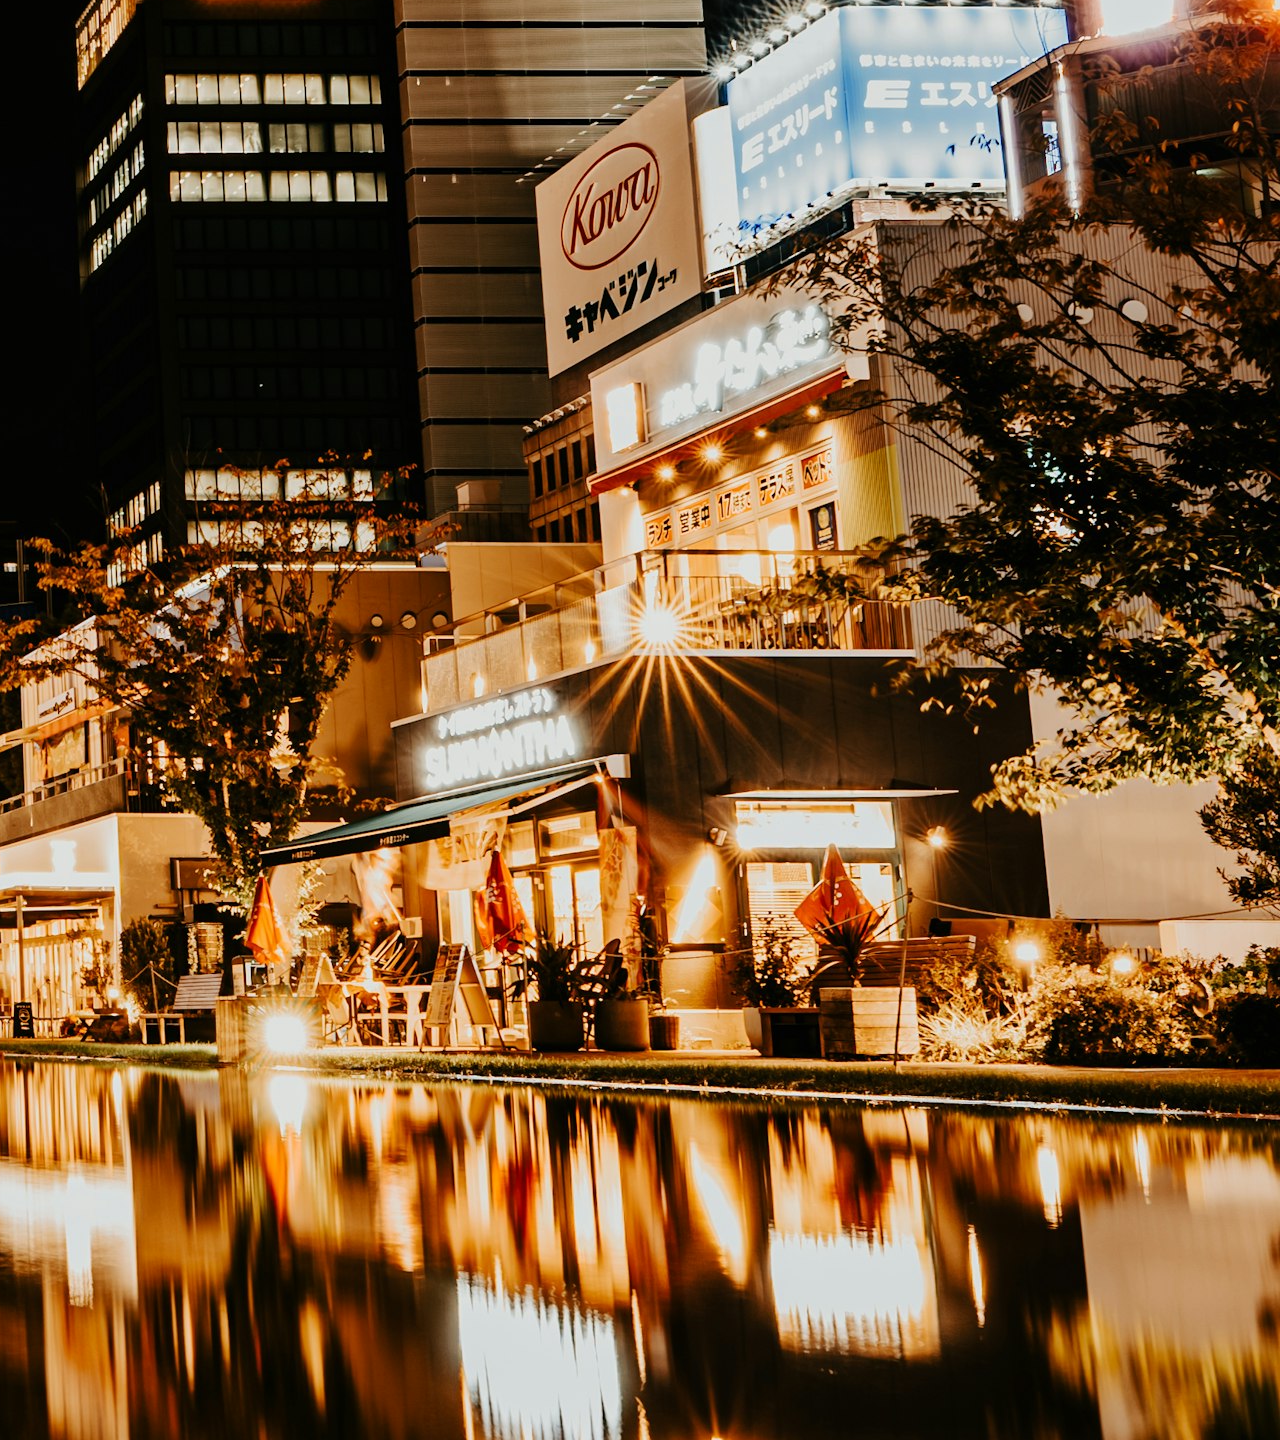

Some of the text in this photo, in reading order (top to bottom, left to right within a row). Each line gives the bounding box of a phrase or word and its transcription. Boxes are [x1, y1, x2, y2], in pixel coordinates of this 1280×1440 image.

[767, 85, 838, 154] エスリード
[569, 161, 656, 256] Kowa
[648, 518, 672, 548] ランチ
[679, 504, 710, 534] 営業中
